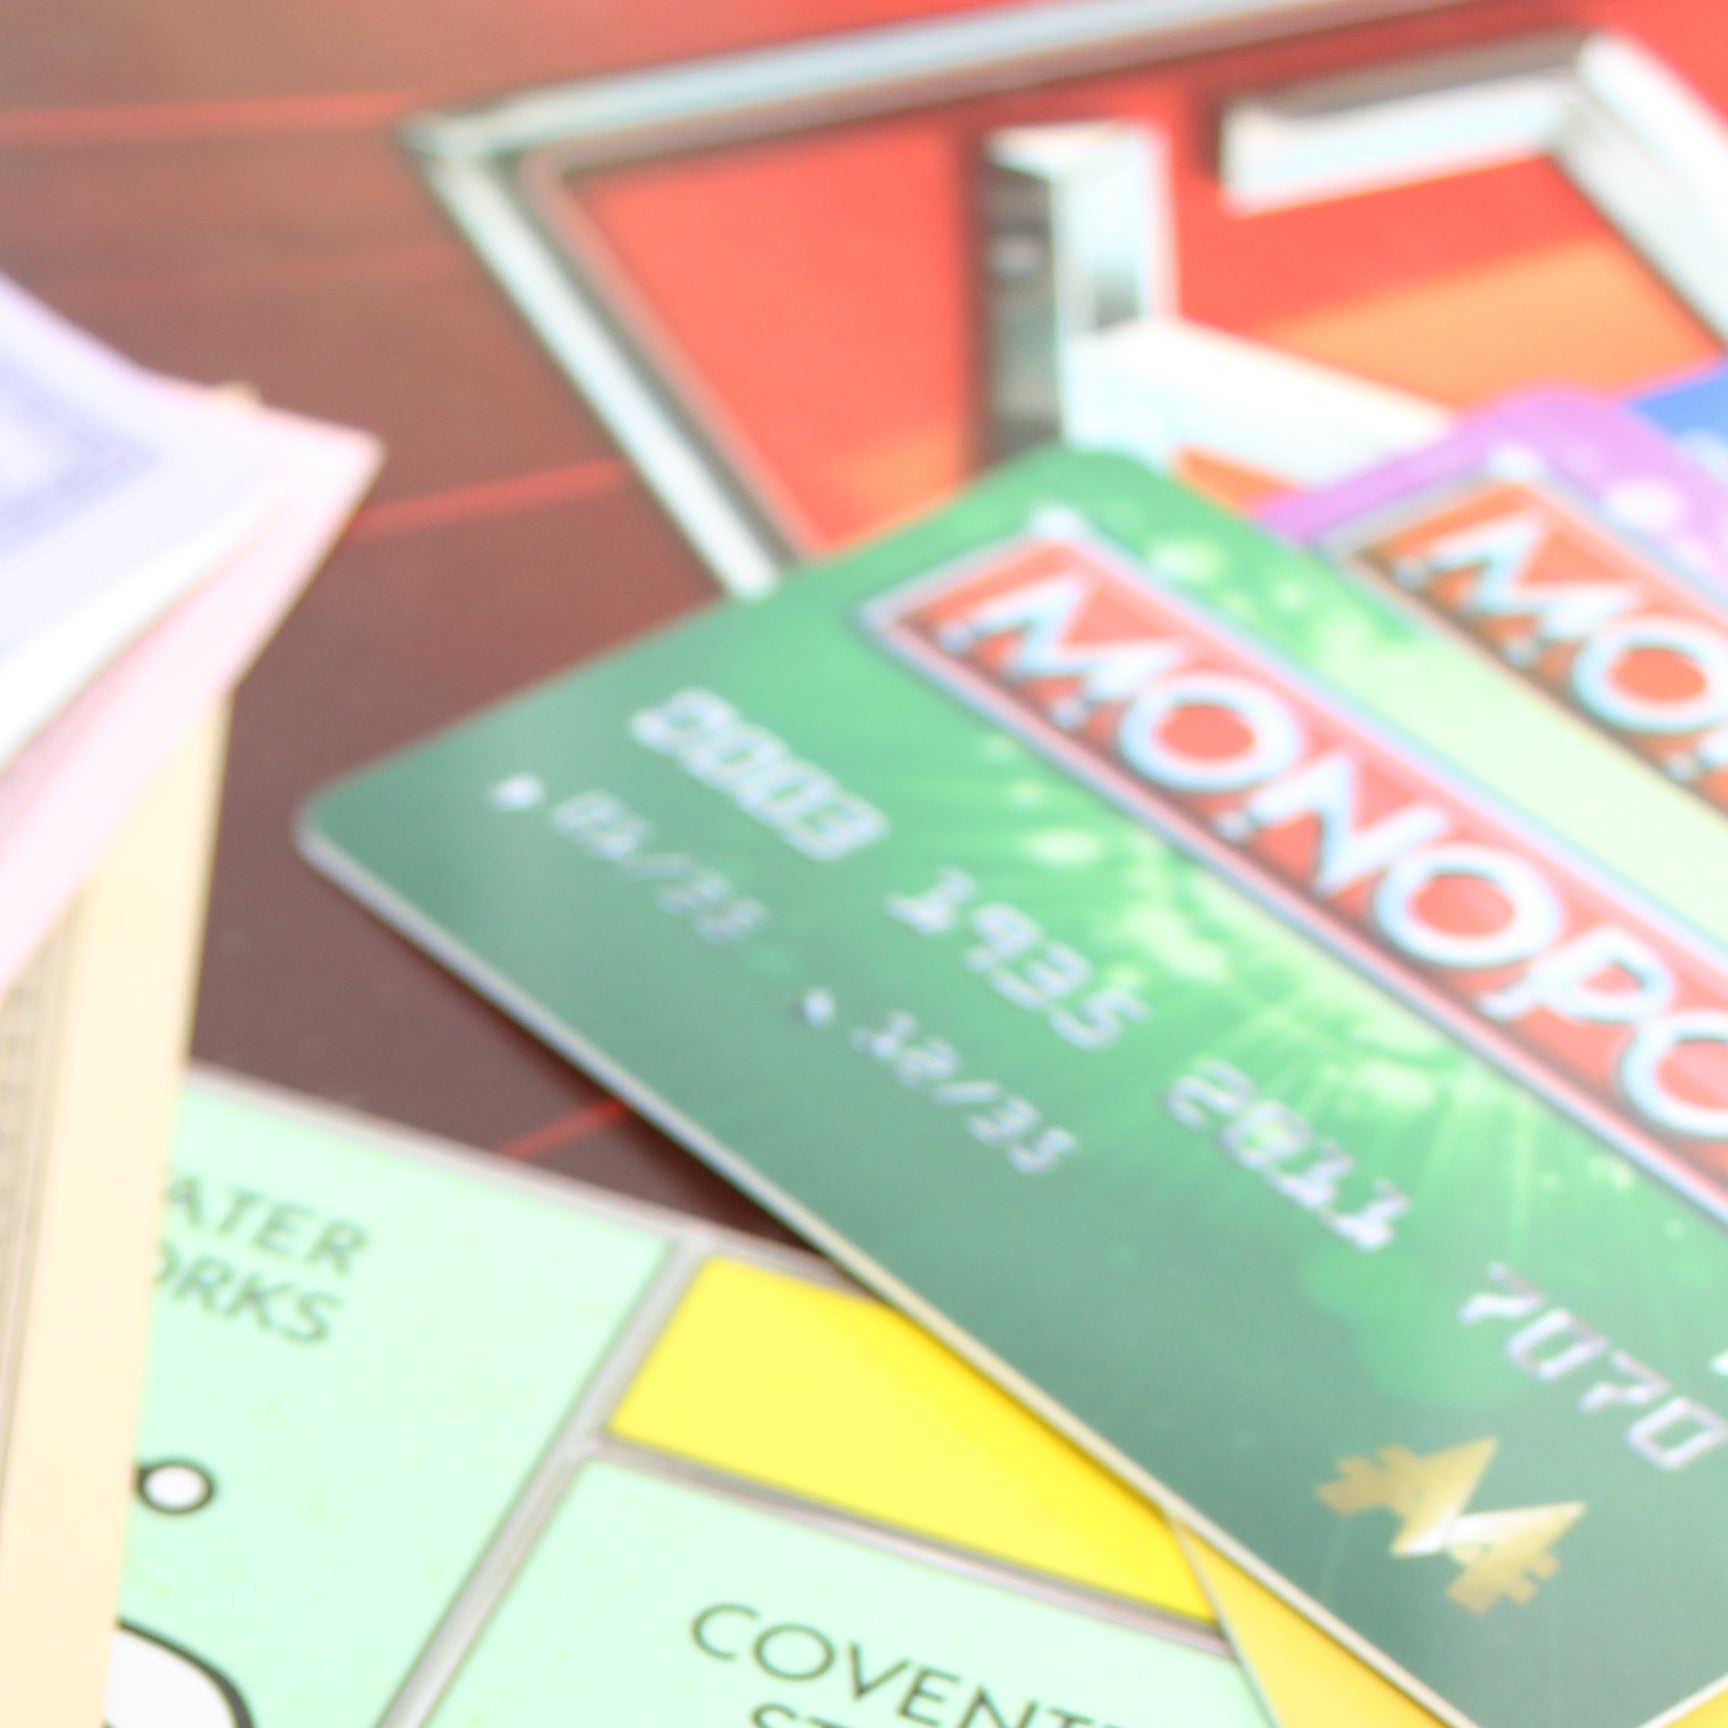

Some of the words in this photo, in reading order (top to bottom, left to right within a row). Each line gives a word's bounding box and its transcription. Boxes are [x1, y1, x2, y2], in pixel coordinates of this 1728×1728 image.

[1392, 515, 1728, 782] MO
[884, 868, 1152, 1050] 1935
[1162, 1057, 1410, 1252] 2011
[162, 1175, 369, 1277] ATER
